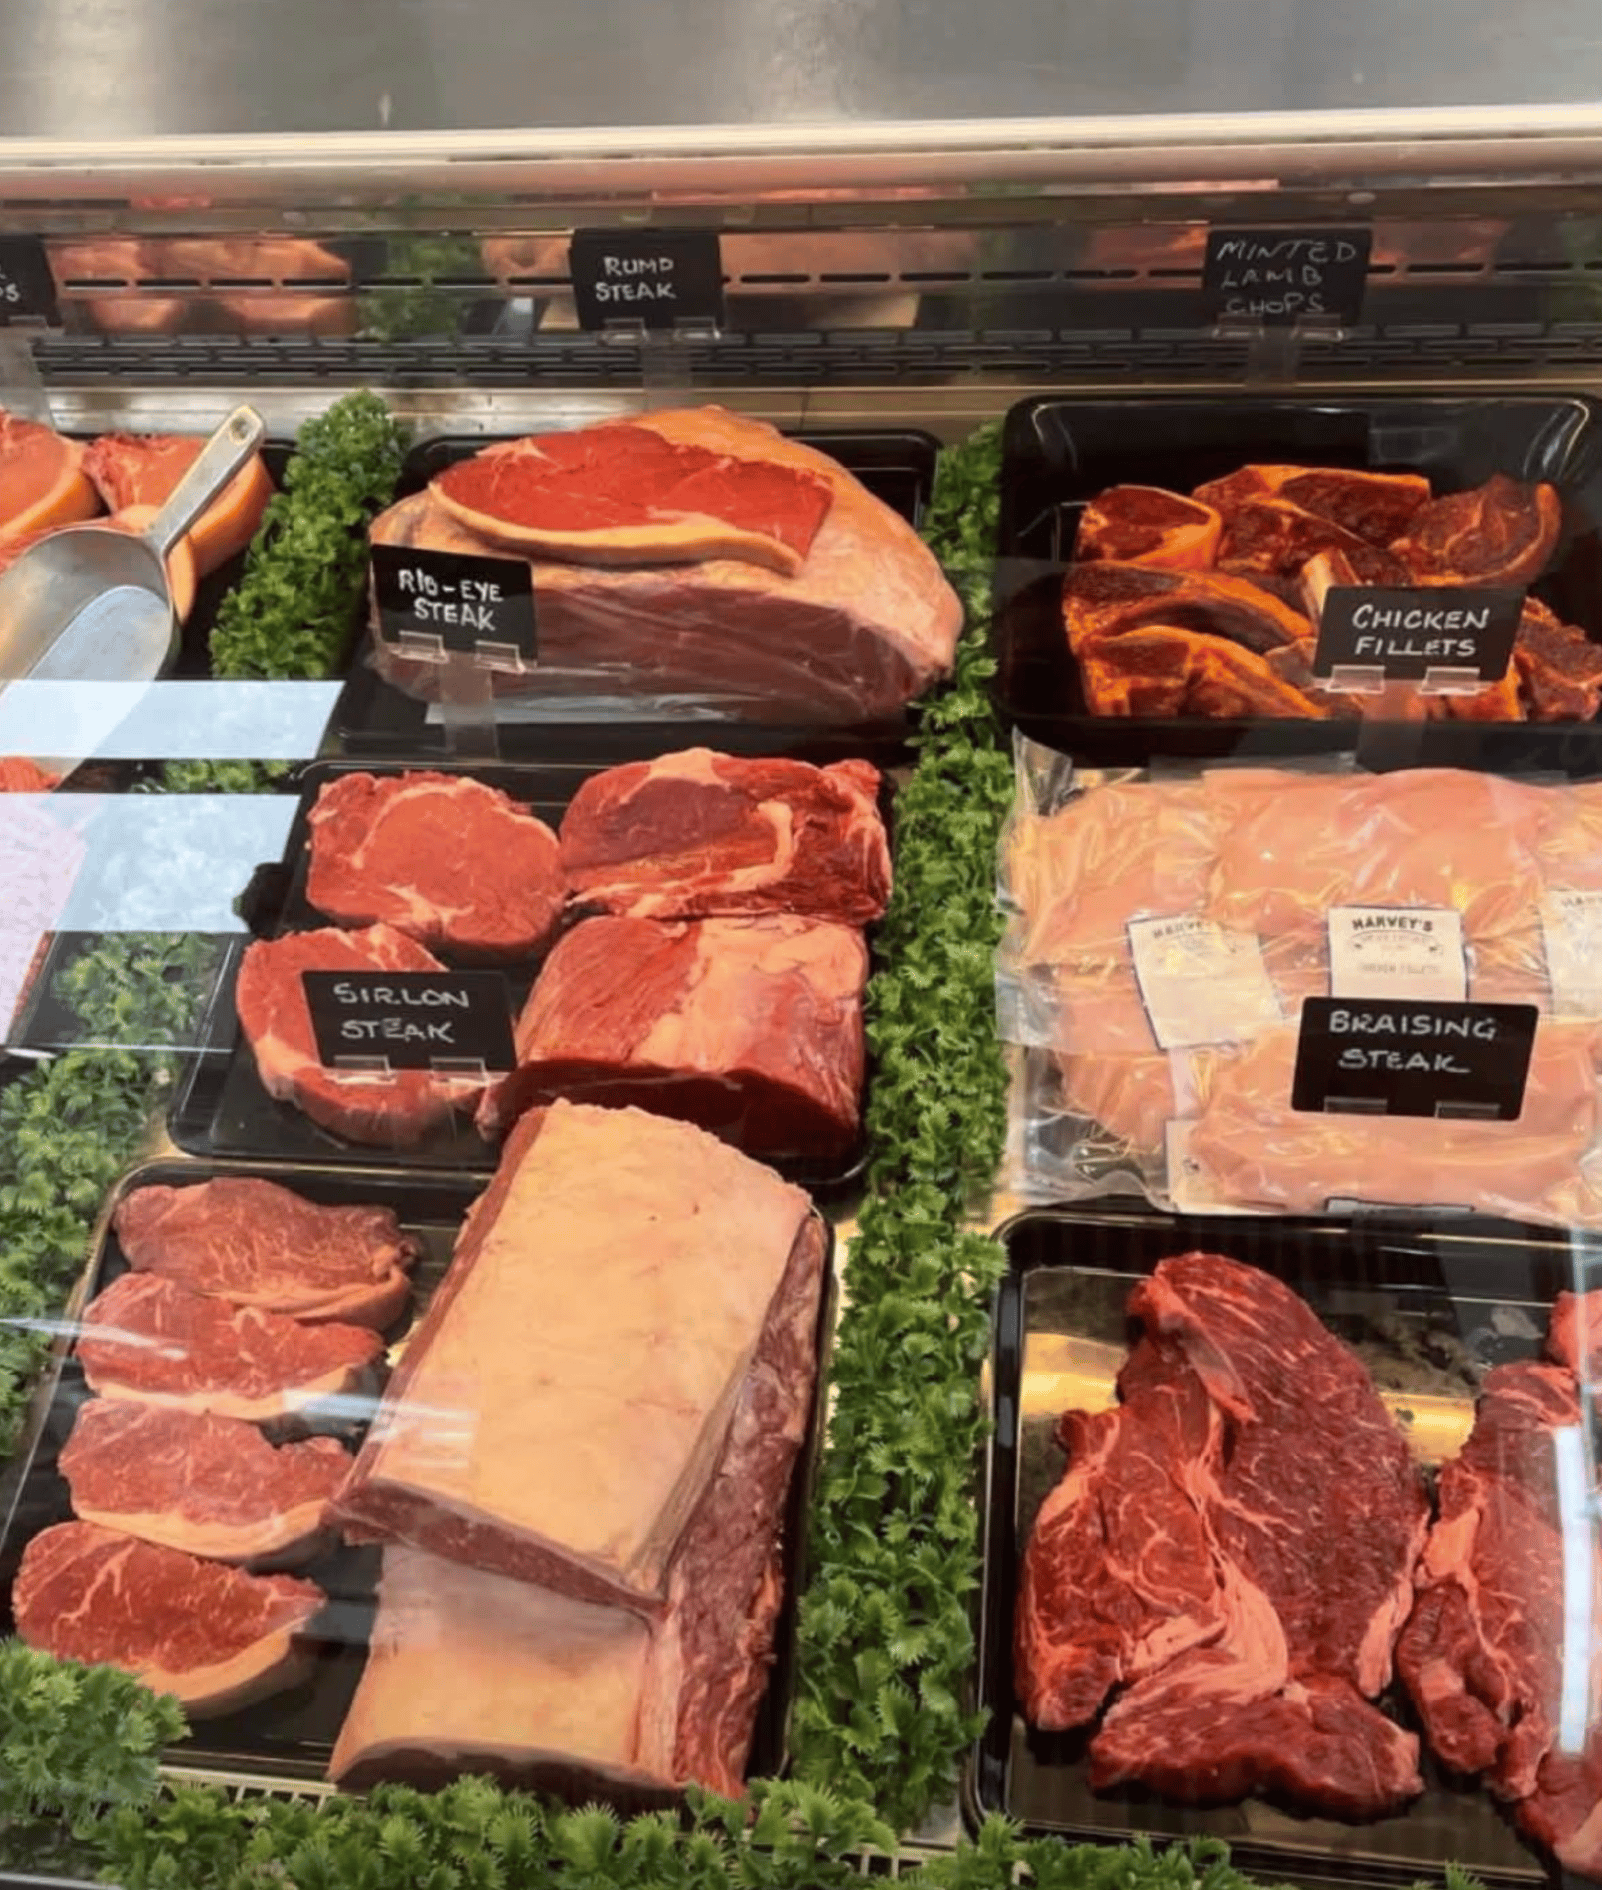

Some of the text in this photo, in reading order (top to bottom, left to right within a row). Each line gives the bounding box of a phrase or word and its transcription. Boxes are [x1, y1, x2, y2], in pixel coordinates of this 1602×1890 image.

[1216, 239, 1356, 263] MINTED
[1221, 265, 1322, 289] LAMB
[595, 281, 677, 301] STEAK
[1226, 292, 1325, 314] CHOPS
[414, 597, 496, 632] STEAK
[1352, 604, 1490, 630] CHICKEN
[1354, 636, 1477, 657] FILLETS
[340, 1018, 456, 1043] STEAK
[1329, 1009, 1497, 1040] BRAISING
[1337, 1048, 1472, 1074] STEAK
